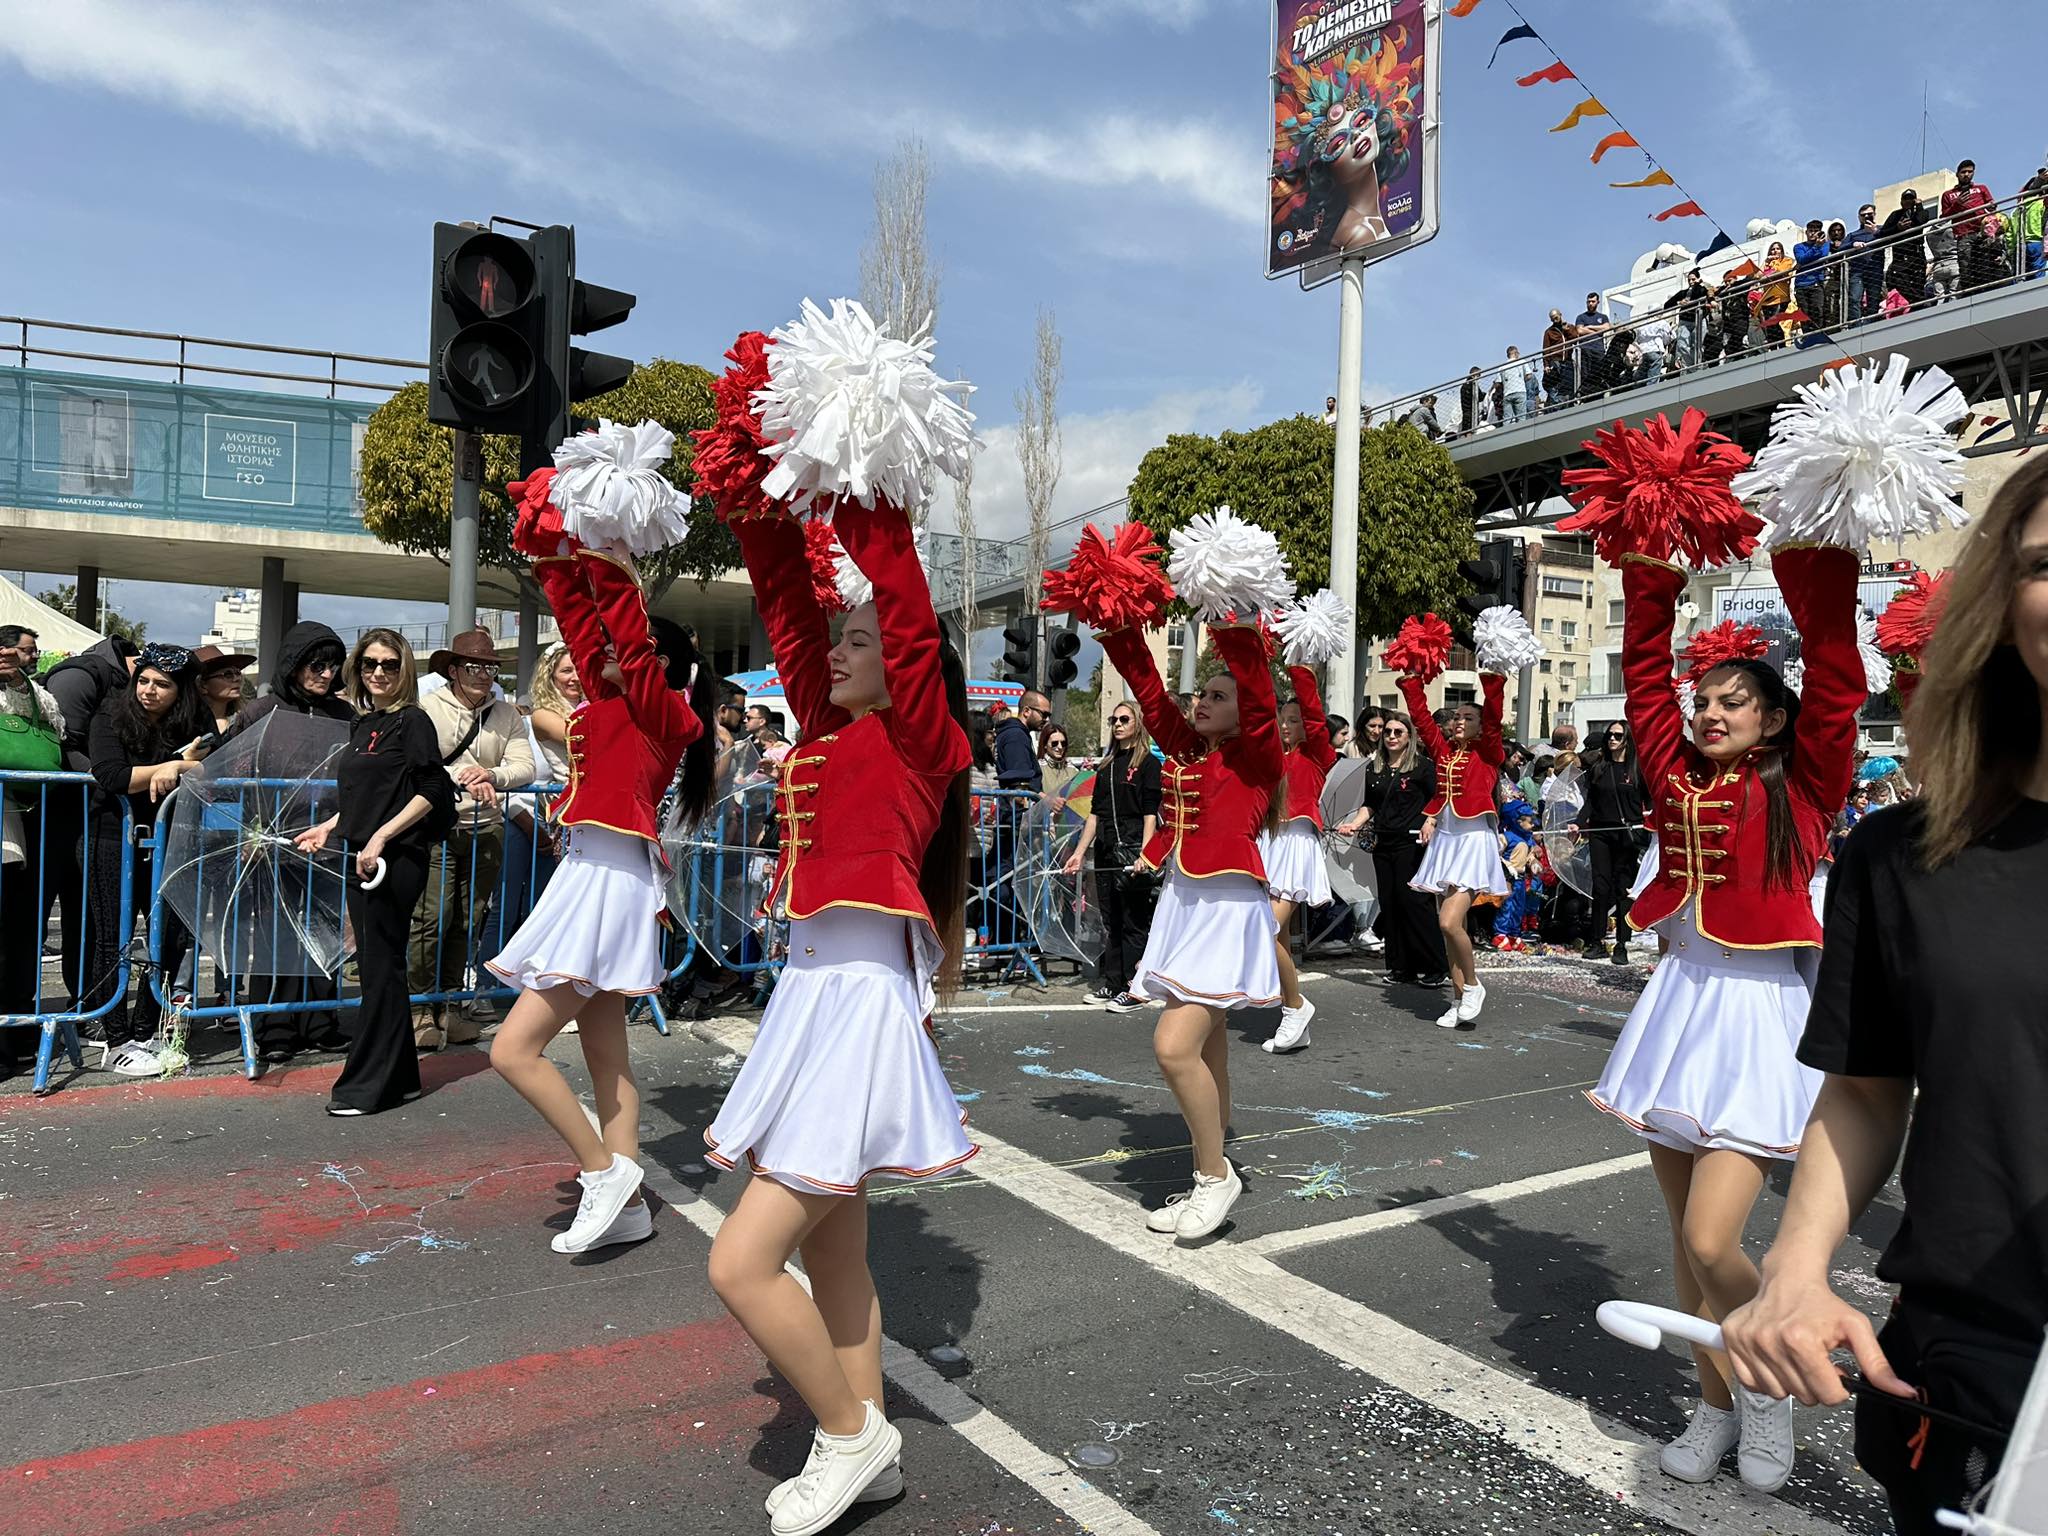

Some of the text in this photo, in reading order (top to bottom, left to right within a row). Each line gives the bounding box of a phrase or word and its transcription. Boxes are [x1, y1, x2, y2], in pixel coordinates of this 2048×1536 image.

[1319, 0, 1343, 15] 07-1
[1292, 0, 1390, 51] ΤΟ ΛΕΜΕΣΙ
[1303, 2, 1392, 61] ΚΑΡΝΑΒΑΛΙ
[1314, 30, 1380, 66] Limassol Carnival
[225, 432, 276, 445] ΜΟΥΣΕΙΟ
[219, 443, 282, 456] ΑΘΛΗΤΙΚΗΣ
[227, 454, 274, 467] ΙΣΤΟΡΙΑΣ
[236, 472, 265, 485] ΓΣΟ
[57, 497, 144, 509] ΑΝΑΣΤΑΣΙΟΣ ΑΝΔΡΕΟΥ
[1723, 598, 1775, 613] Bridge
